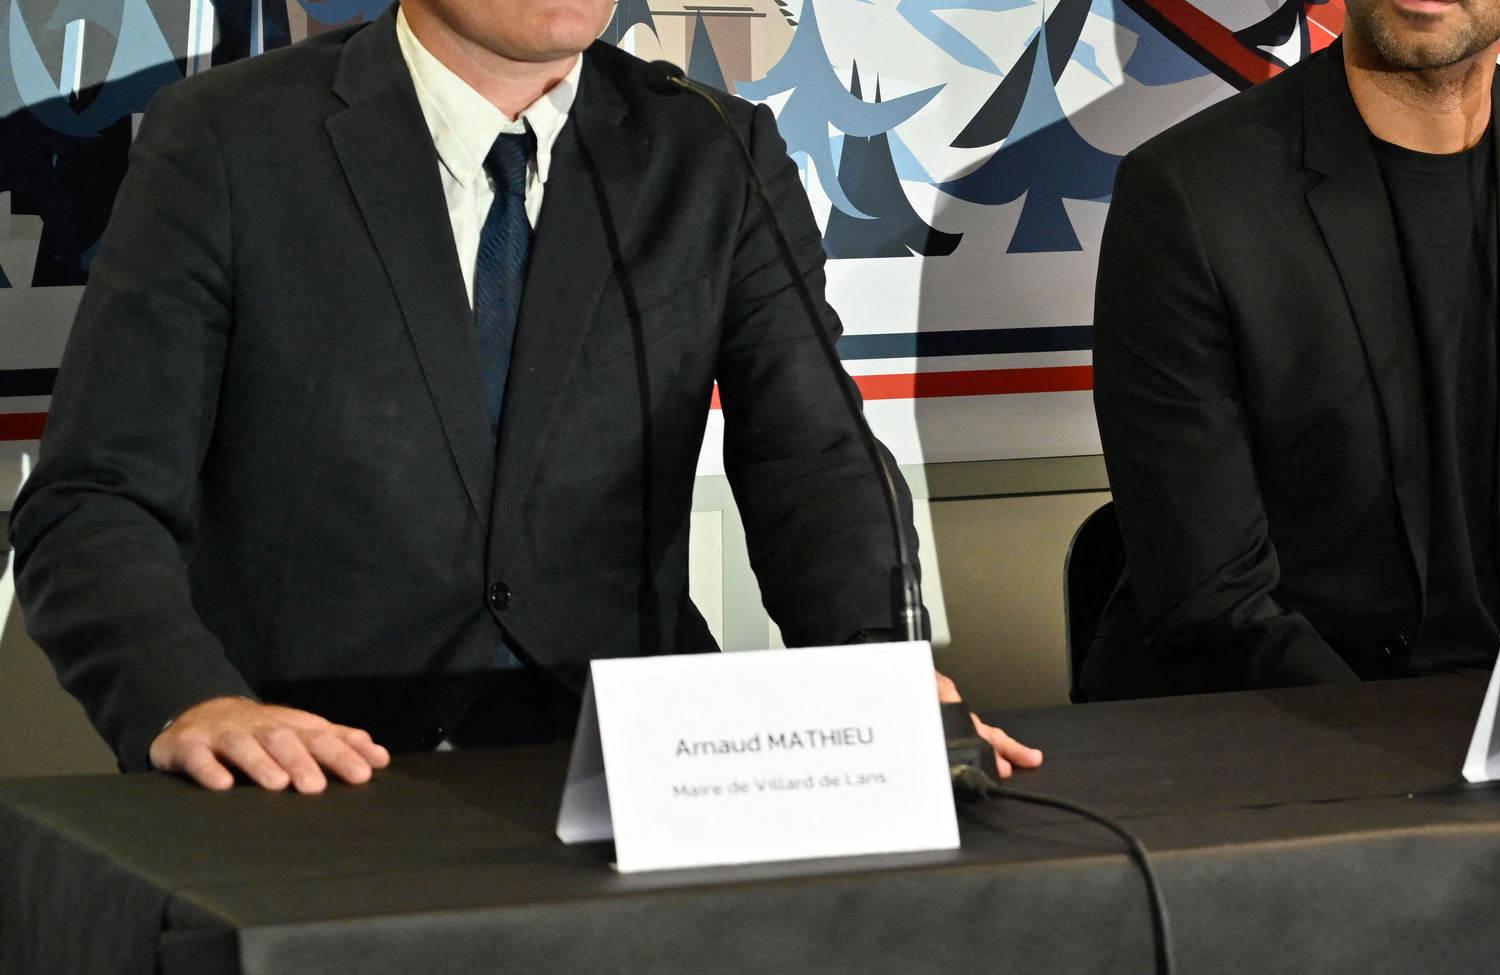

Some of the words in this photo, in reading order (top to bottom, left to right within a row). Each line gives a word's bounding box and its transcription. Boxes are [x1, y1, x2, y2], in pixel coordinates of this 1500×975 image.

[674, 731, 762, 758] Arnaud
[767, 725, 875, 752] MATHIEU
[671, 782, 723, 799] Maire
[727, 778, 750, 795] de
[753, 773, 815, 793] Villard
[819, 772, 841, 789] de
[844, 770, 888, 787] Lans
